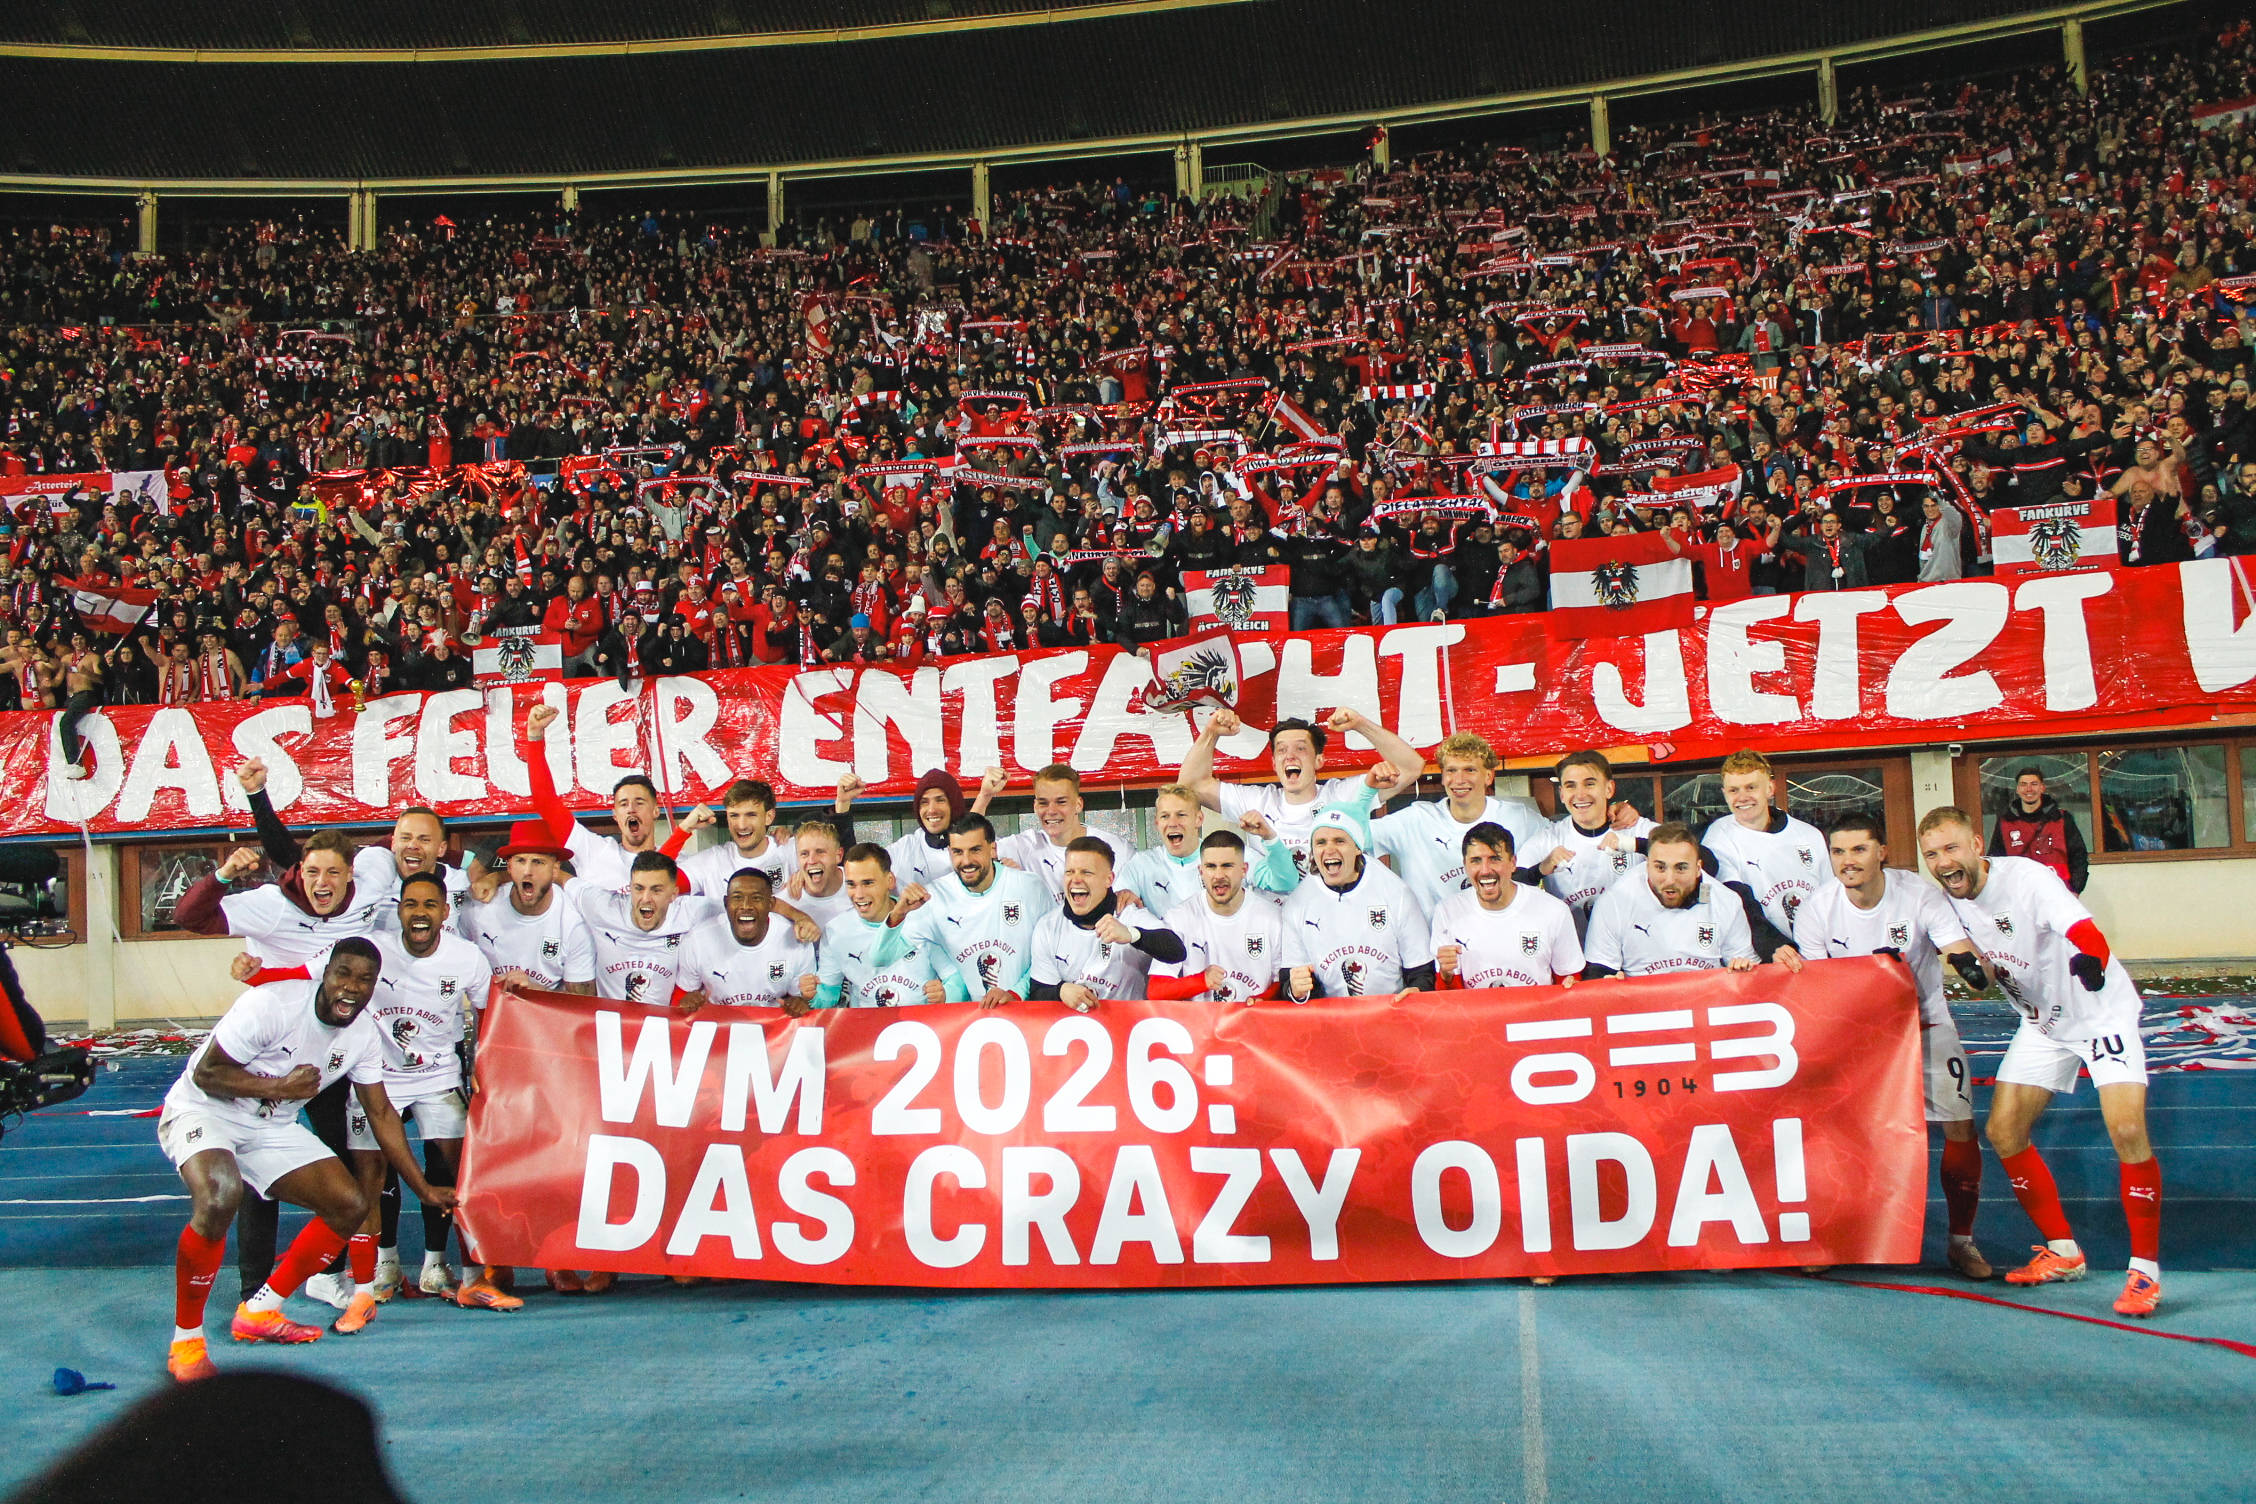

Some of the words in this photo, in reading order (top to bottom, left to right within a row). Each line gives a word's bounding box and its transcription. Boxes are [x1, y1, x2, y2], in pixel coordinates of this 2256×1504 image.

[2019, 503, 2089, 521] FANKURVE
[490, 625, 542, 638] ANKURVE
[1197, 620, 1269, 632] ÖSTREICH
[46, 703, 313, 823] DAS
[353, 675, 734, 808] FEUER
[1594, 572, 2114, 733] JETZT
[1440, 866, 1465, 884] EXCIT
[1564, 886, 1597, 905] XCITED
[1761, 879, 1794, 907] EXCITED
[1796, 878, 1816, 893] ABOU
[956, 939, 990, 964] EXCITED
[992, 938, 1016, 957] ABOUT
[1319, 946, 1355, 971] EXCITED
[1358, 945, 1390, 964] ABOUT
[1998, 951, 2030, 970] ABOUT
[492, 965, 521, 977] CITED
[524, 968, 553, 988] ABOUT
[606, 960, 643, 974] EXCITED
[646, 961, 673, 978] ABOUT
[1645, 957, 1682, 975] EXCITED
[861, 975, 888, 998] EXCITED
[891, 974, 919, 991] ABOUT
[1086, 973, 1118, 992] ABOUT
[1229, 970, 1261, 991] ABOUT
[1467, 967, 1503, 989] EXCITED
[1506, 969, 1538, 987] ABOUT
[719, 992, 753, 1006] XCITED
[372, 1006, 413, 1021] EXCITED
[415, 1009, 444, 1027] ABOUT
[594, 1009, 825, 1136] WM
[871, 1015, 1237, 1136] 2026:
[1612, 1077, 1699, 1099] 1904
[575, 1133, 856, 1266] DAS
[903, 1143, 1362, 1268] CRAZY
[1411, 1117, 1811, 1259] OIDA!
